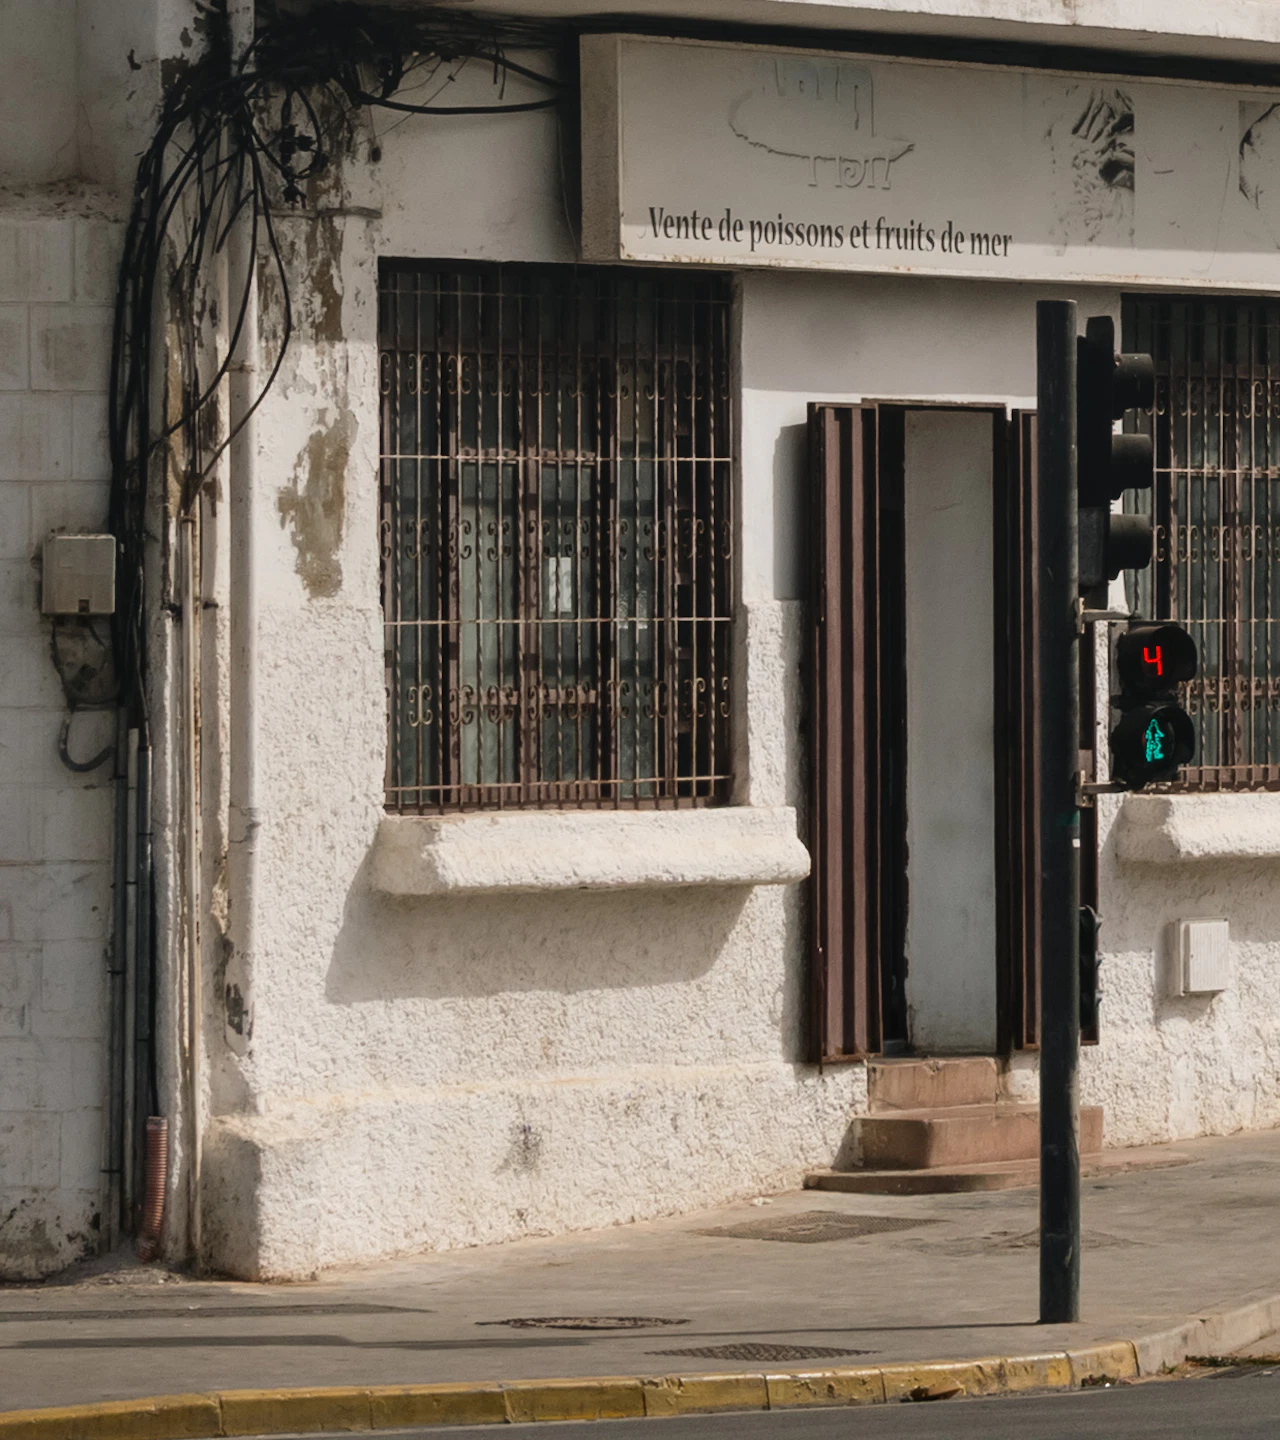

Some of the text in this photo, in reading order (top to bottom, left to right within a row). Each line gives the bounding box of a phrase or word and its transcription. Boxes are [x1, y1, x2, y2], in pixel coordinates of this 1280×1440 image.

[648, 206, 1013, 257] Vente de poissons et fruits de mer
[1143, 645, 1163, 676] 4
